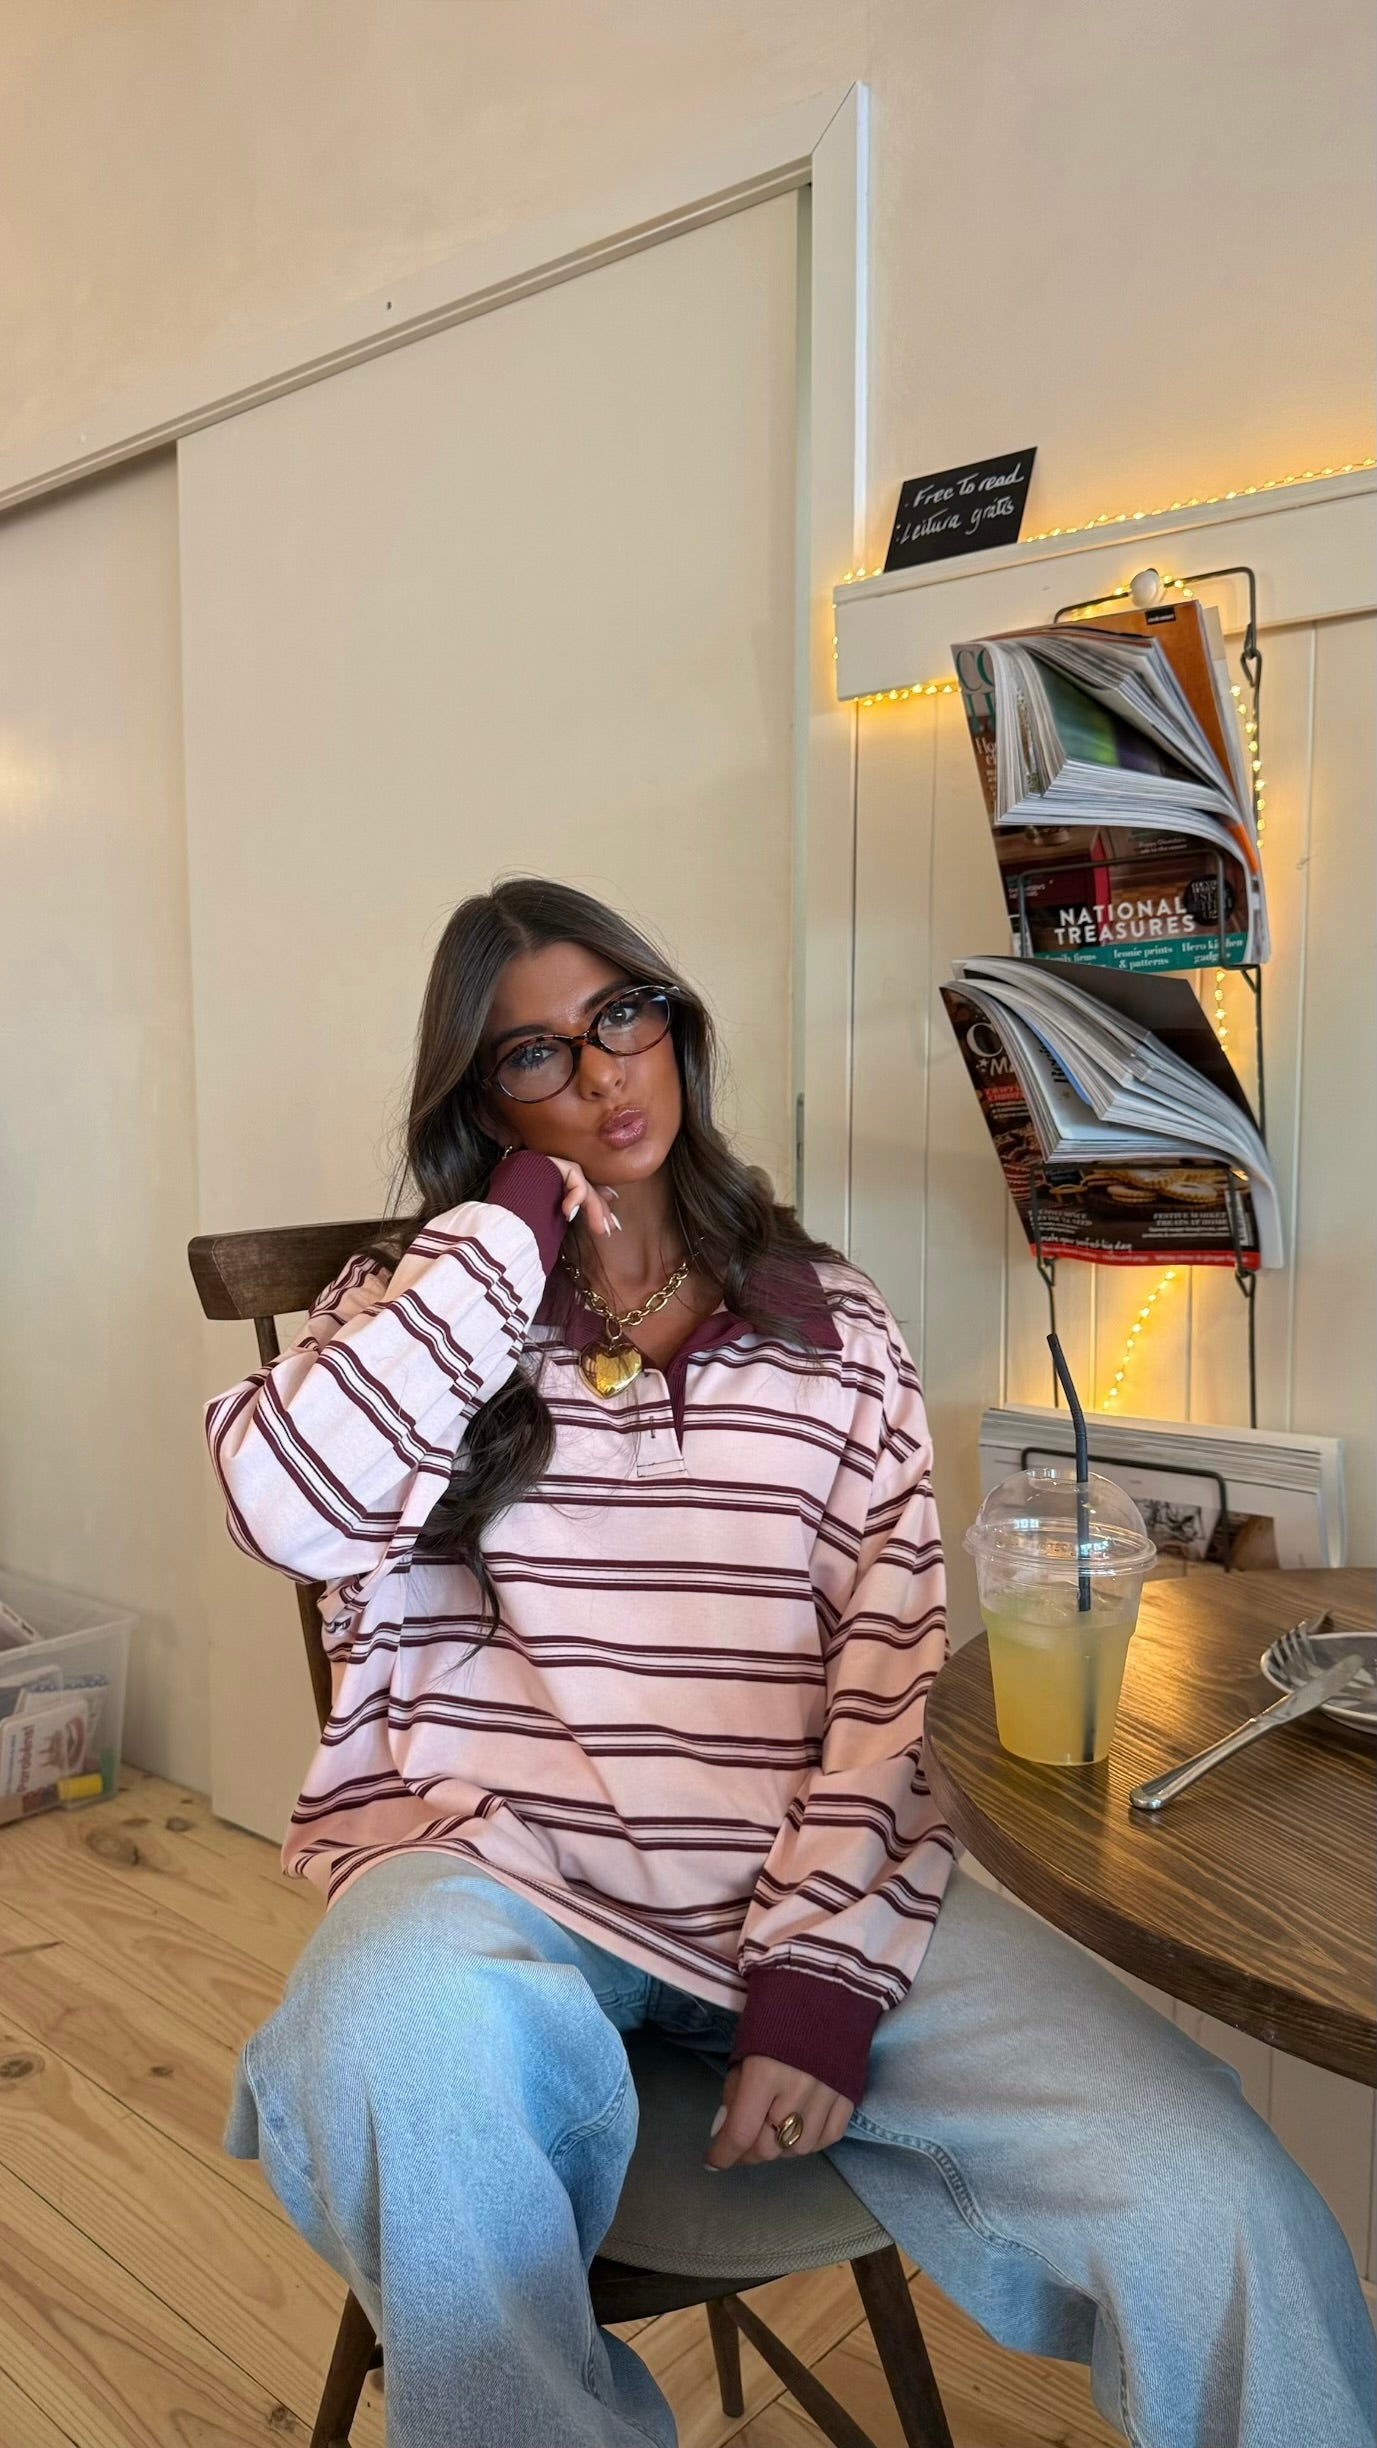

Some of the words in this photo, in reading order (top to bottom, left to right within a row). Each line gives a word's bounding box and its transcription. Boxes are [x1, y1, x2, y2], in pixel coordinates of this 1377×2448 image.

[912, 484, 955, 508] Free
[978, 462, 1025, 492] read
[1059, 896, 1188, 927] NATIONAL
[1054, 914, 1196, 946] TREASURES
[1143, 945, 1173, 958] prints
[1181, 941, 1207, 953] Hero
[1118, 960, 1127, 969] &
[1129, 957, 1170, 971] patterns
